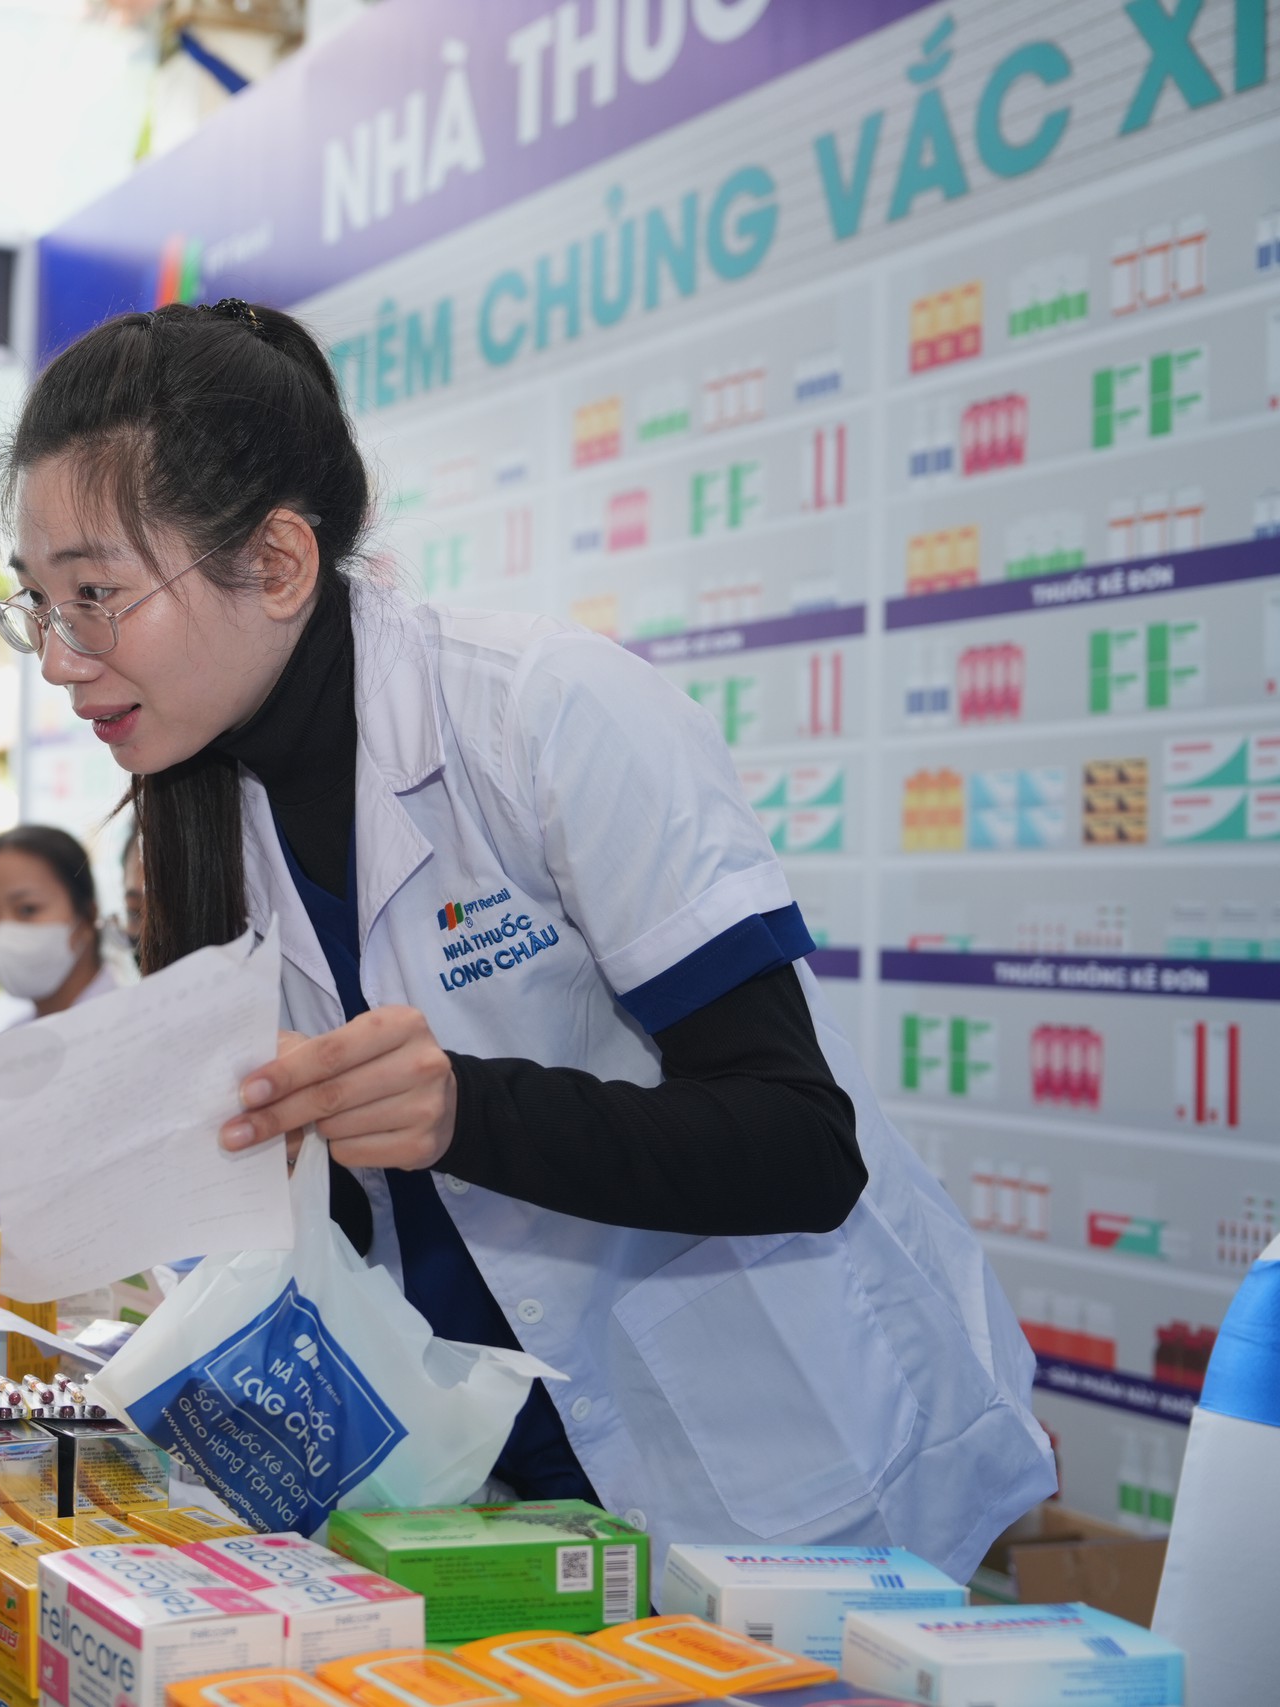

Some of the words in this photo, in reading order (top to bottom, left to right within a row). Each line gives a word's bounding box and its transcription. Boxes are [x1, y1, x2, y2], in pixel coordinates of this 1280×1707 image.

[322, 38, 484, 246] NHÀ
[329, 298, 453, 416] TIÊM
[477, 164, 780, 368] CHỦNG
[814, 14, 1072, 243] VẮC
[479, 888, 512, 911] Retail
[439, 958, 494, 992] LONG
[494, 924, 560, 970] CHÂU
[442, 934, 475, 962] NHÀ
[471, 912, 532, 951] THUỐC
[161, 1407, 272, 1534] www.nhathuoclongchau.com
[178, 1397, 208, 1439] Giao
[206, 1434, 246, 1474] Hàng
[244, 1465, 274, 1501] Tận
[271, 1495, 300, 1527] Nơi
[193, 1389, 220, 1412] Số
[210, 1410, 224, 1422] 1
[219, 1417, 262, 1454] Thuốc
[259, 1450, 284, 1475] Kê
[280, 1472, 309, 1510] Đơn
[285, 1411, 331, 1478] CHÂU
[89, 1550, 218, 1616] Feliccare
[224, 1540, 360, 1606] Feliccare
[724, 1555, 889, 1566] MAGINEW
[40, 1590, 136, 1693] Feliccare
